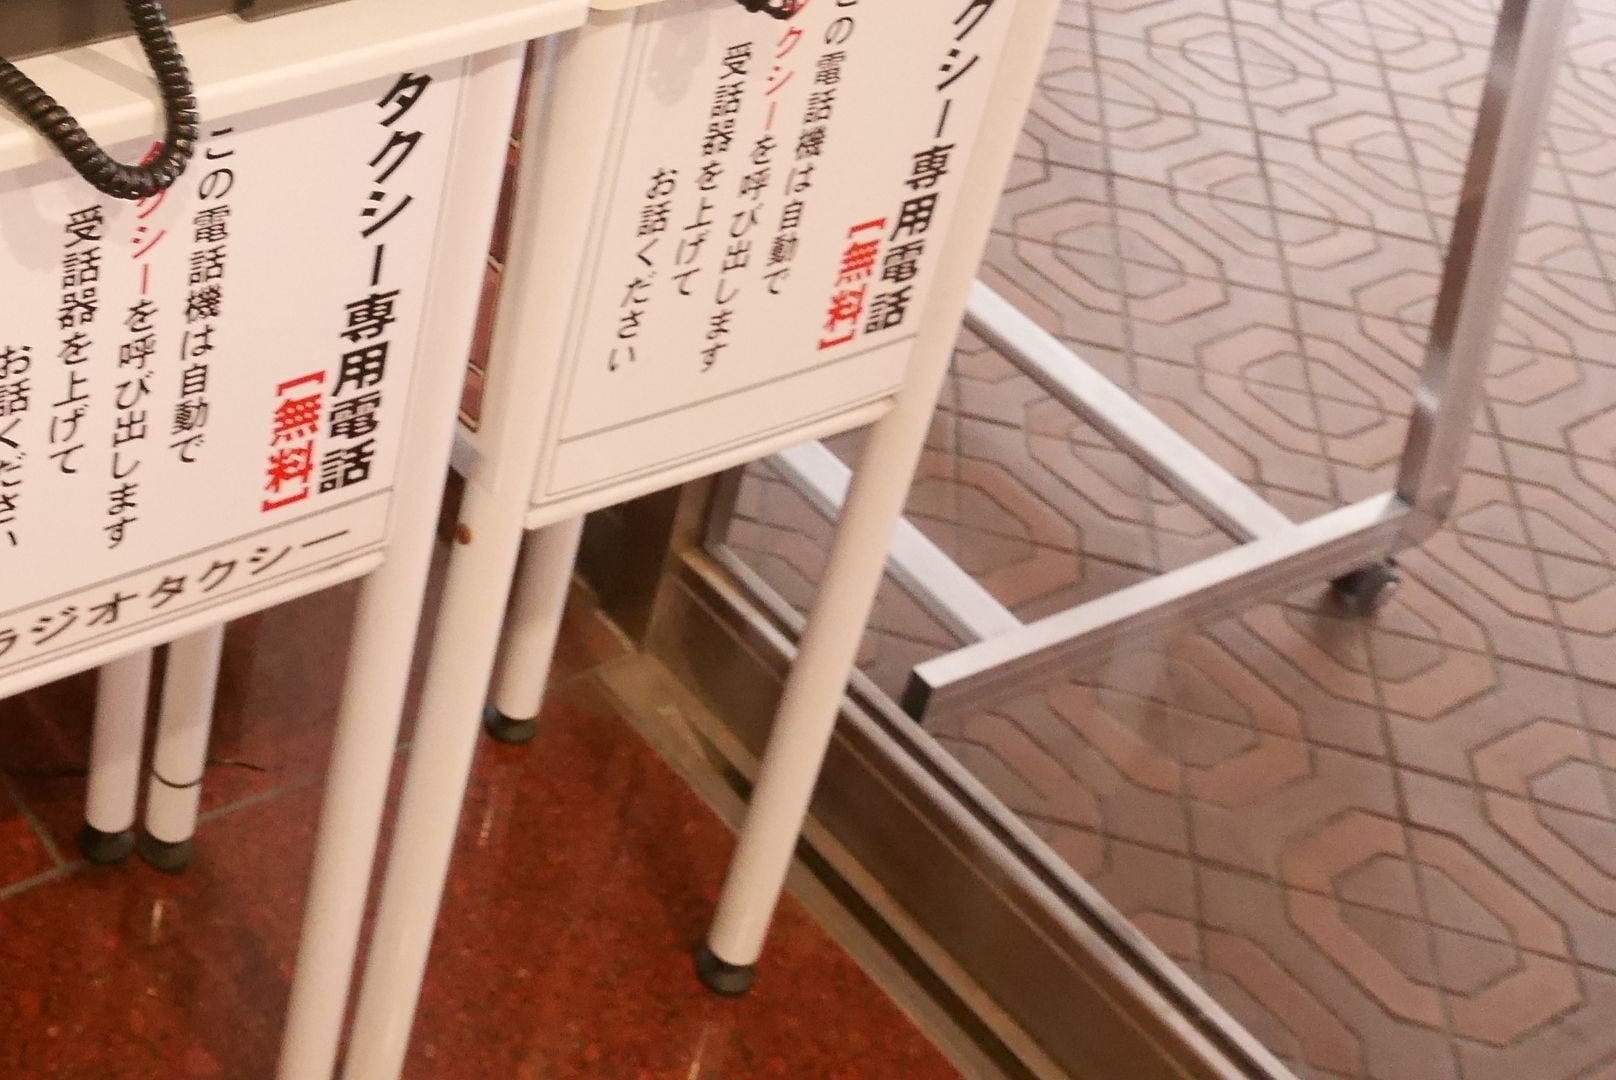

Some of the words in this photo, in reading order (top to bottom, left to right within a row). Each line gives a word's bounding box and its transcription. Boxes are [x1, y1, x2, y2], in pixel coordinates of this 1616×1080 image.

[169, 126, 237, 466] この電話機は自動で
[317, 70, 433, 497] タクシー専用電話
[608, 166, 680, 373] お話ください
[672, 40, 755, 297] 受話器を上げて
[48, 203, 107, 476] 受話器を上げて
